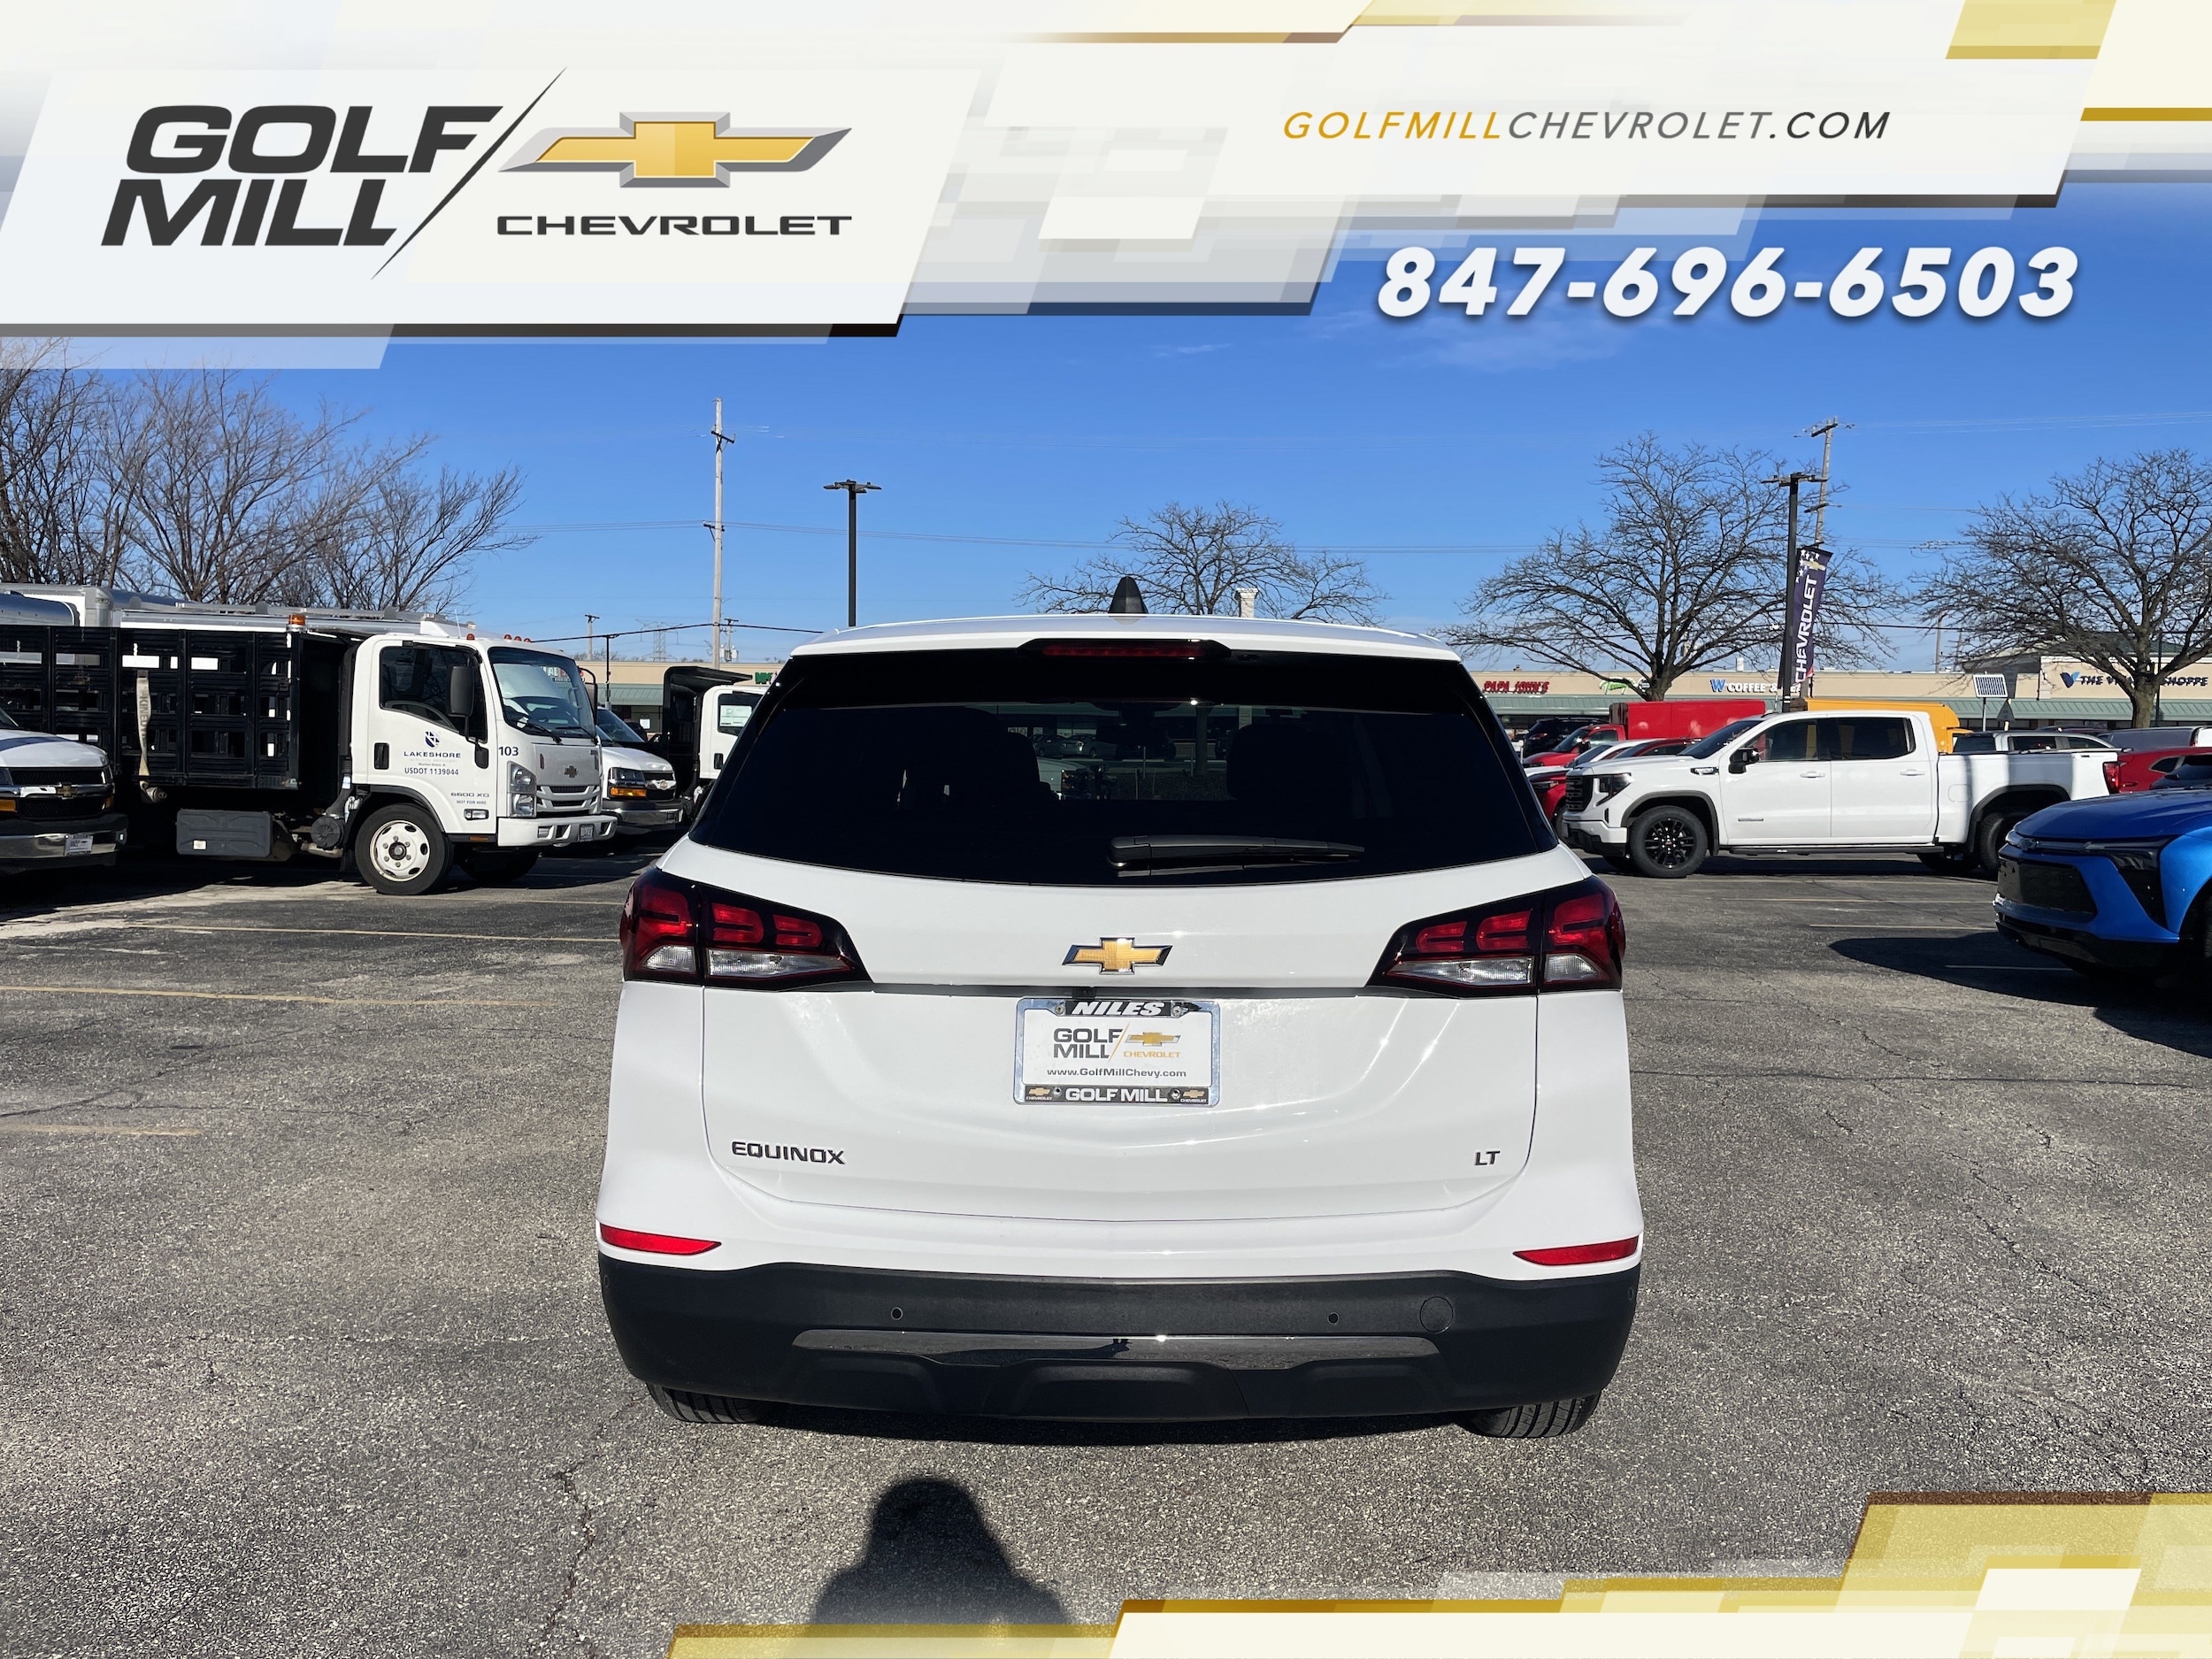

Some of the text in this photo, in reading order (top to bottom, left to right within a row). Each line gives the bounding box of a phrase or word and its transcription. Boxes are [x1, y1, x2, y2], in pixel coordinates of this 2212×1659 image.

[1795, 575, 1817, 683] CHEVROLET
[1484, 680, 1509, 693] PAPA
[1727, 682, 1766, 693] COFFEE
[2080, 676, 2103, 686] THE
[498, 746, 519, 757] 103
[1071, 1001, 1165, 1017] NILES
[1053, 1027, 1124, 1044] GOLF
[1053, 1043, 1110, 1059] MILL
[1124, 1050, 1181, 1059] CHEVROLET
[1047, 1067, 1187, 1078] www.GolfMillChevy.com
[1064, 1087, 1169, 1102] GOLF MILL
[732, 1141, 846, 1165] EQUINOX
[1474, 1150, 1501, 1166] LT
